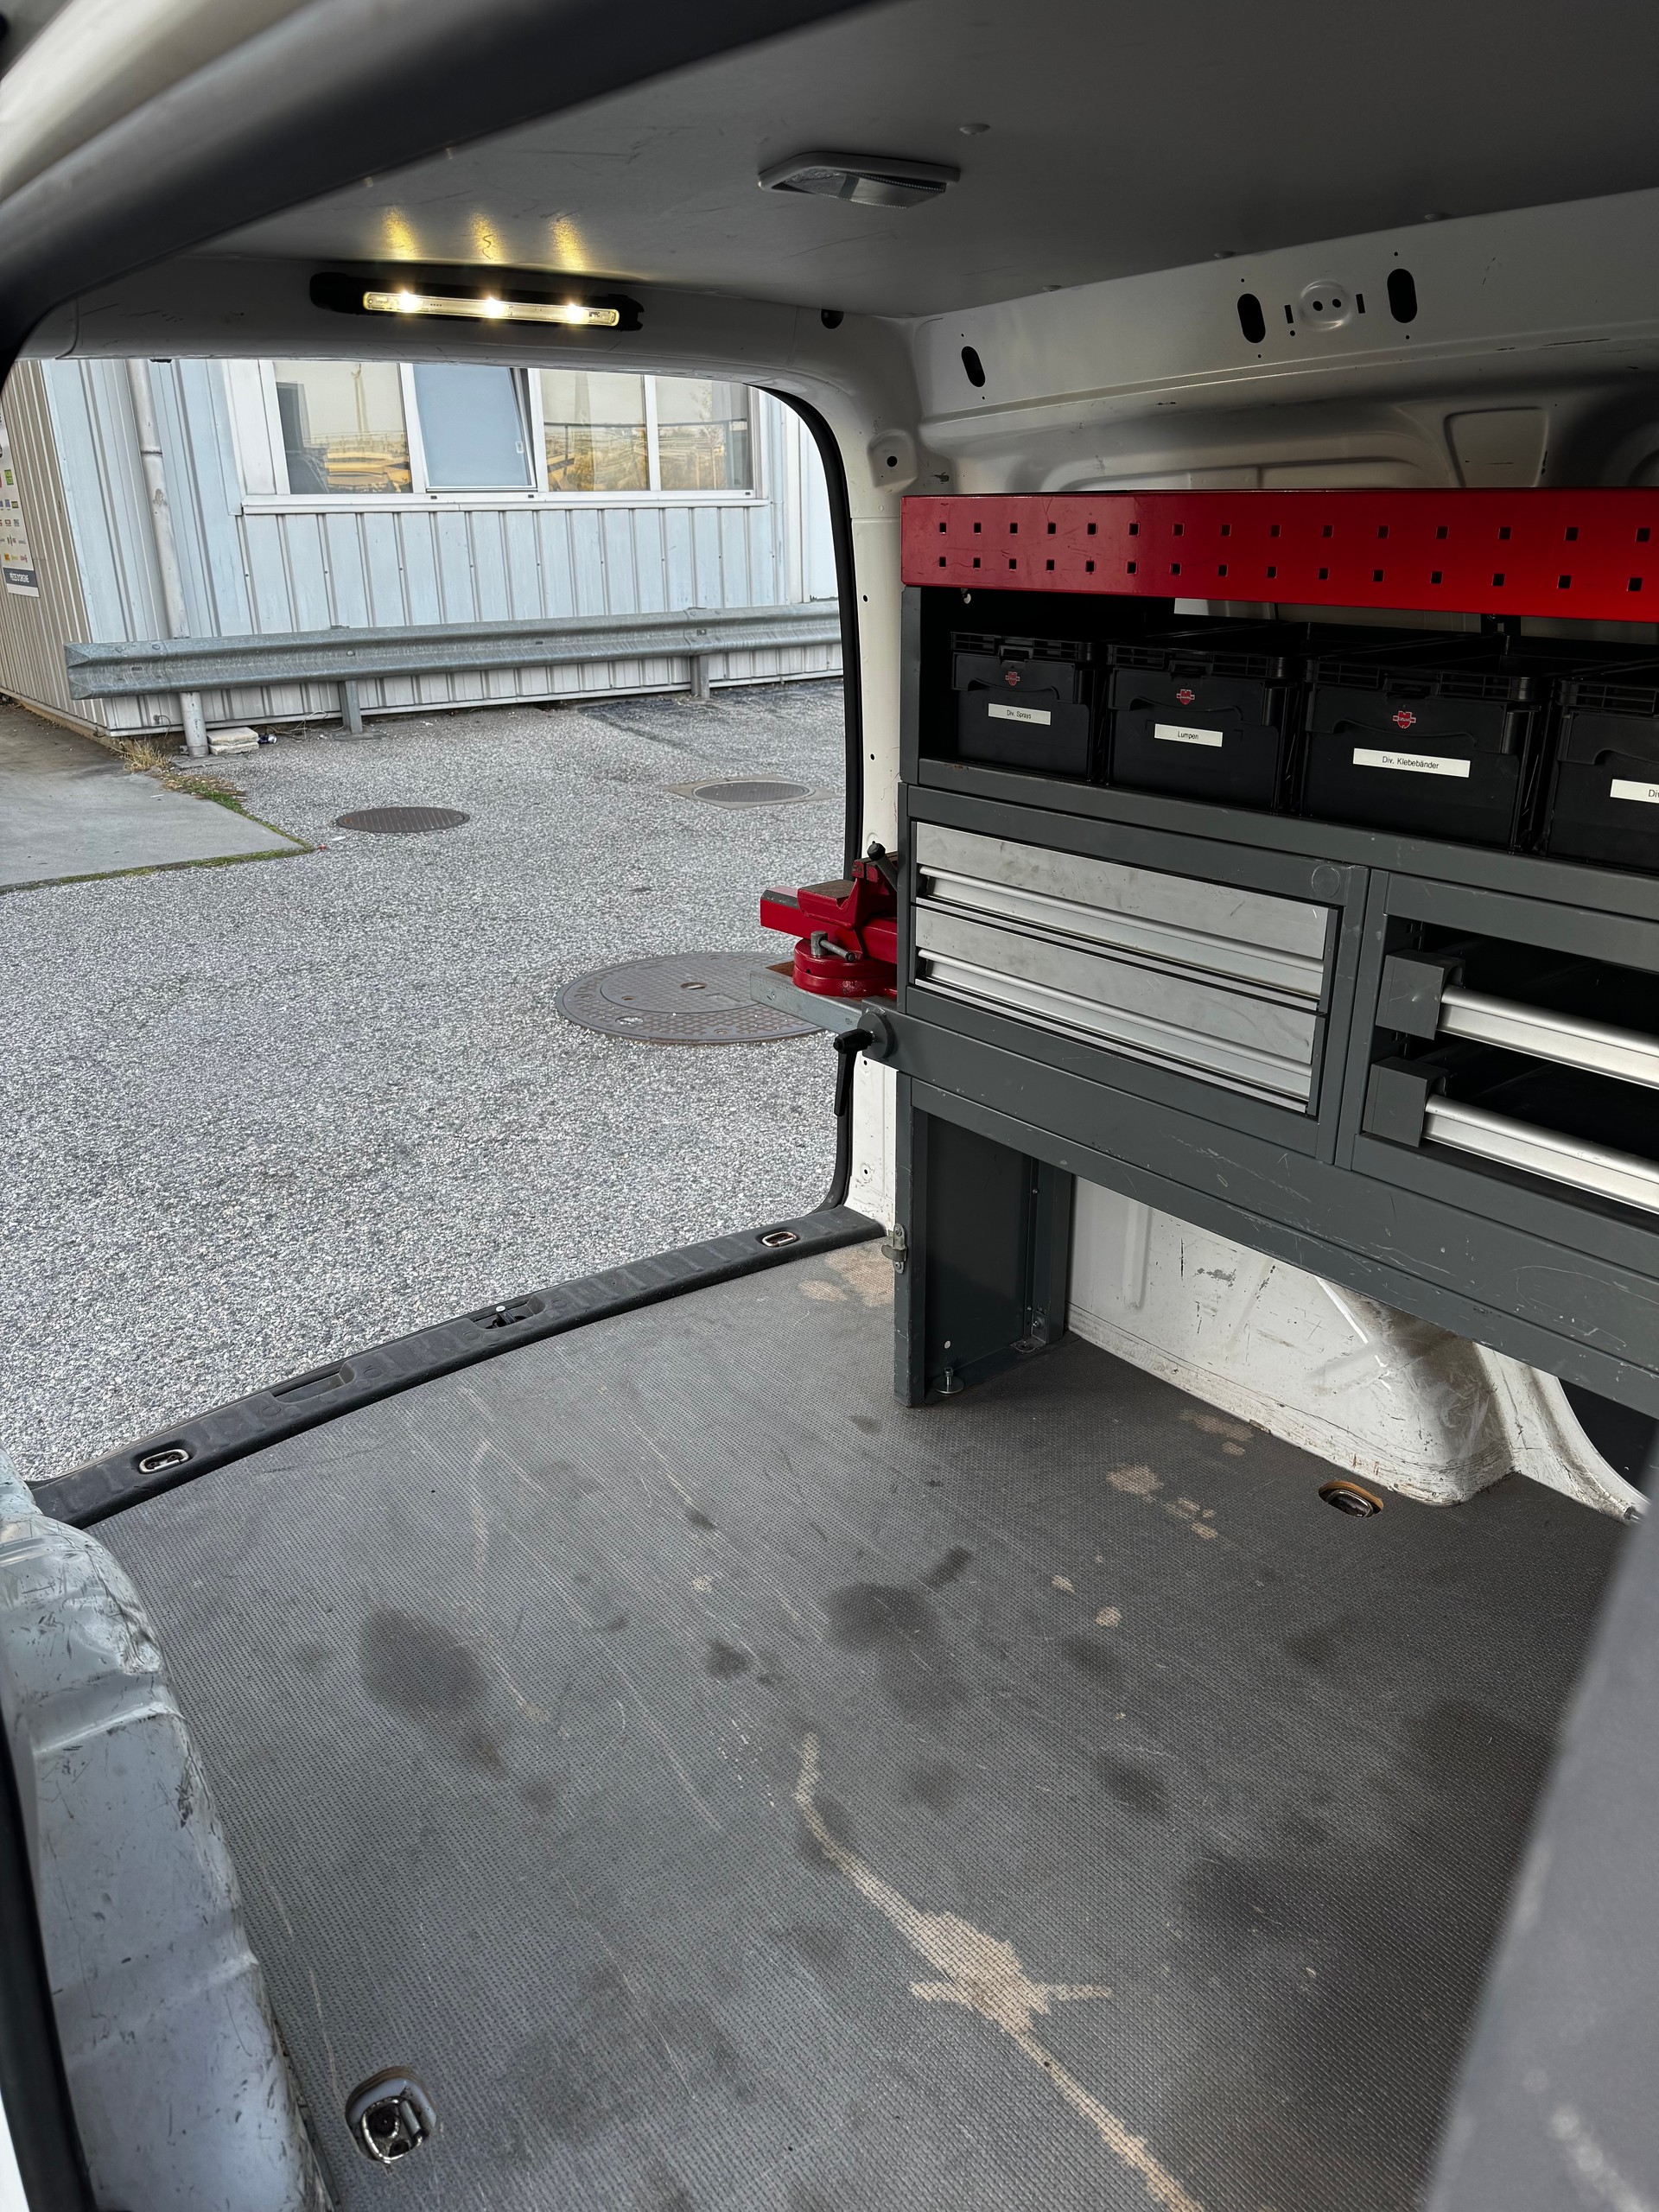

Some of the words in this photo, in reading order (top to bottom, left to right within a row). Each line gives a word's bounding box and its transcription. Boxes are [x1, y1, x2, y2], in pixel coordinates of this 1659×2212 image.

[1178, 731, 1198, 740] Lumpen
[1382, 756, 1395, 765] Div.
[1396, 758, 1439, 769] Klebebänder
